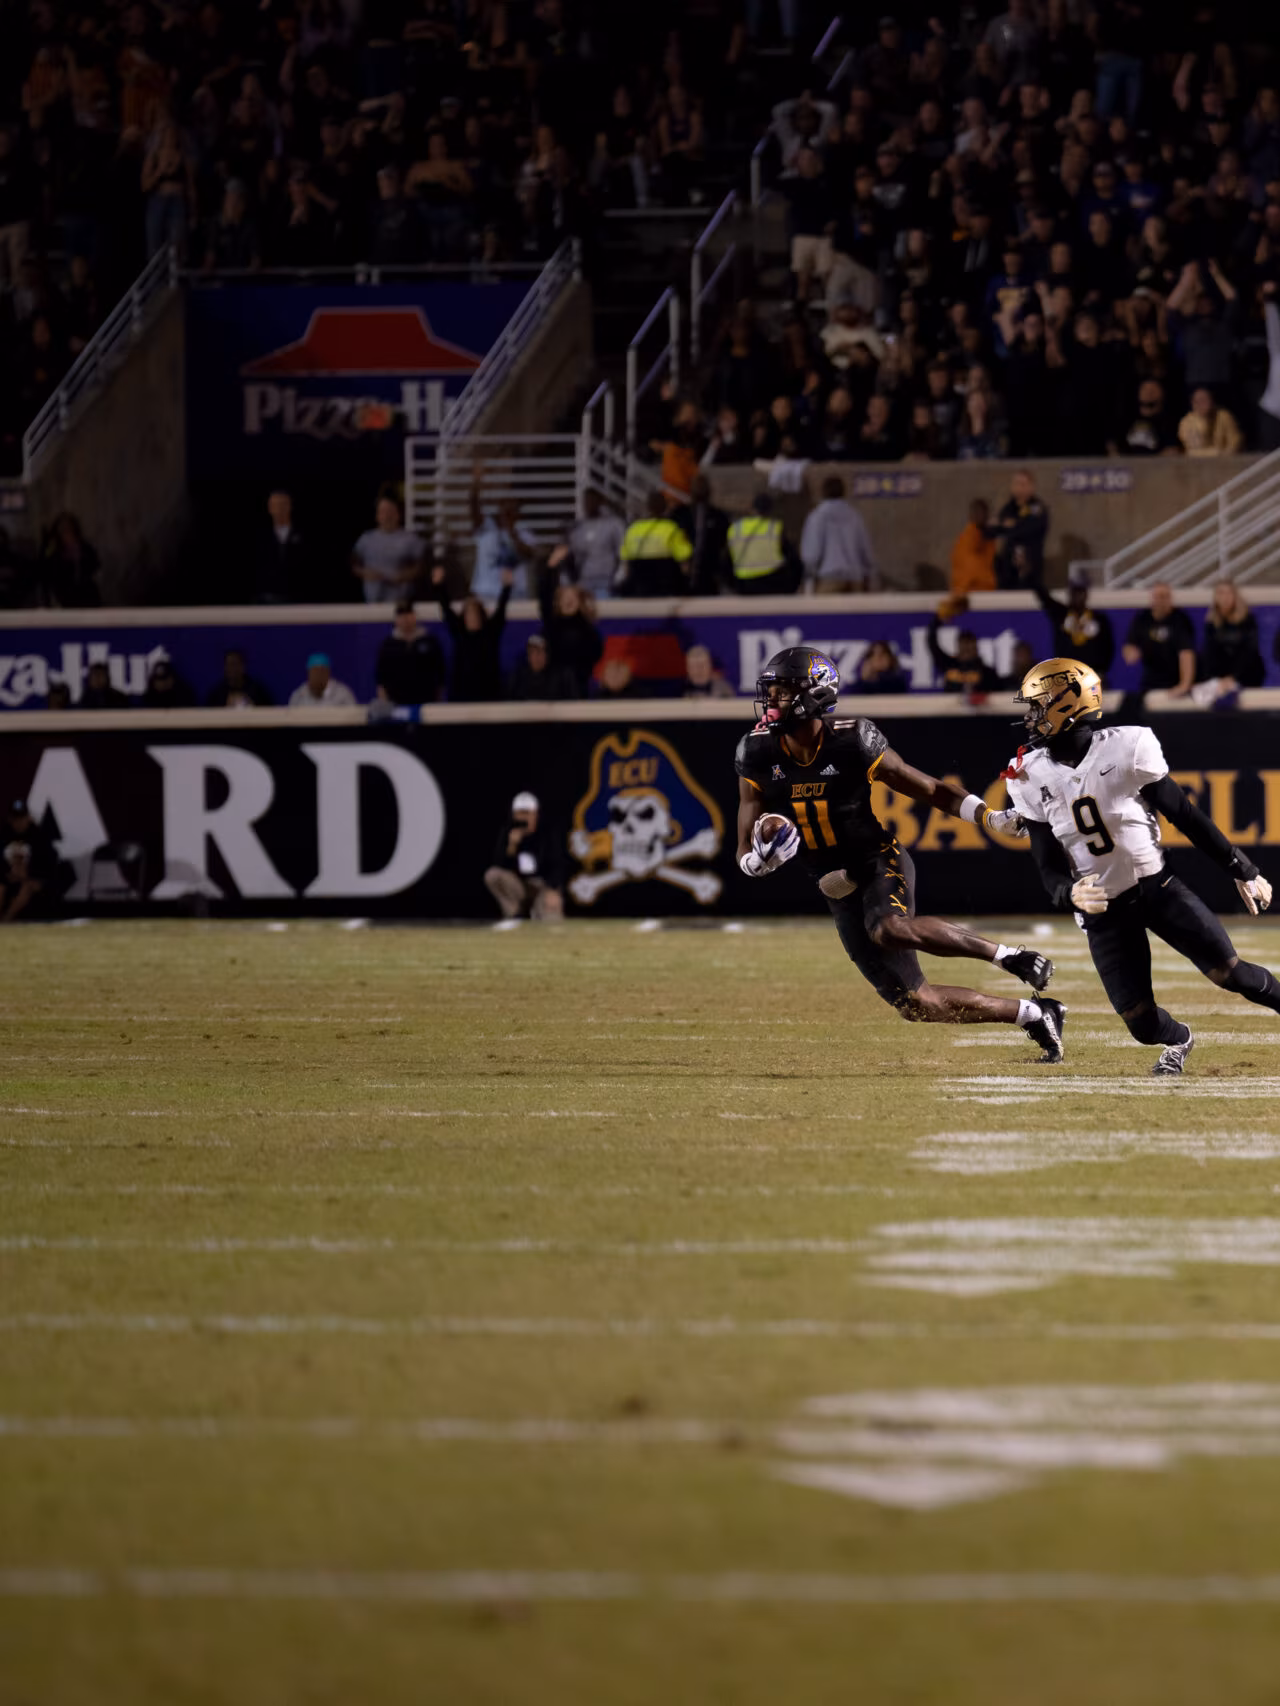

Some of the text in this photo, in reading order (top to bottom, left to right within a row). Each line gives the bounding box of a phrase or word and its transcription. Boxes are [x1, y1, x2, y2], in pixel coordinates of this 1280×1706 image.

[242, 380, 392, 439] Pizz
[608, 756, 660, 789] ECU
[790, 782, 827, 799] ECU
[791, 799, 838, 850] 11
[1072, 796, 1115, 856] 9
